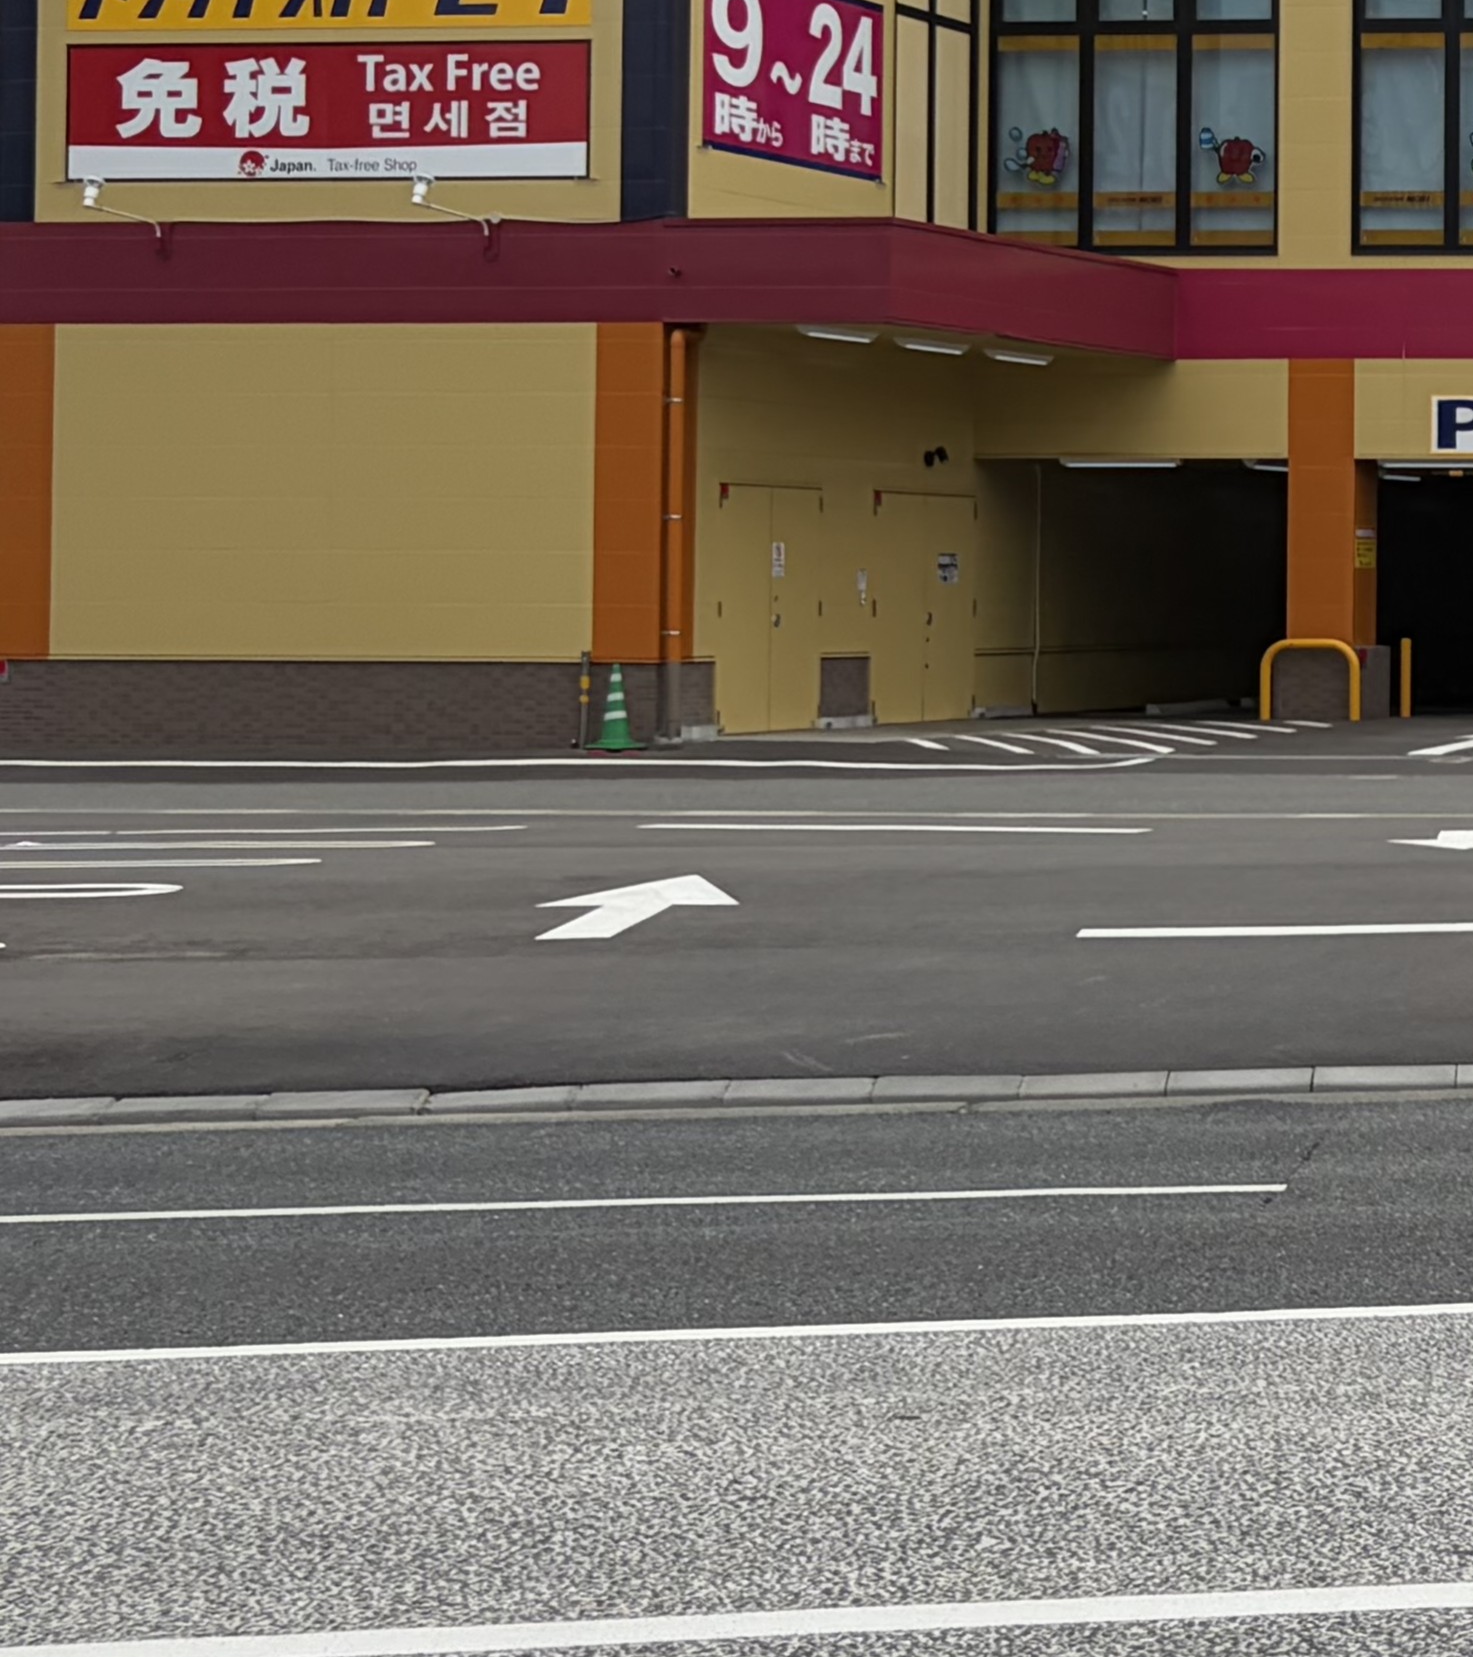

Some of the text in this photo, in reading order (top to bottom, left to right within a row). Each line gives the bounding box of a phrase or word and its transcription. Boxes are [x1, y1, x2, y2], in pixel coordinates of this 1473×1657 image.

[117, 58, 310, 140] 免税
[357, 54, 540, 92] Tax Free
[714, 92, 874, 167] 時から 時まで
[327, 158, 379, 172] Tax-free
[384, 158, 417, 173] Shop
